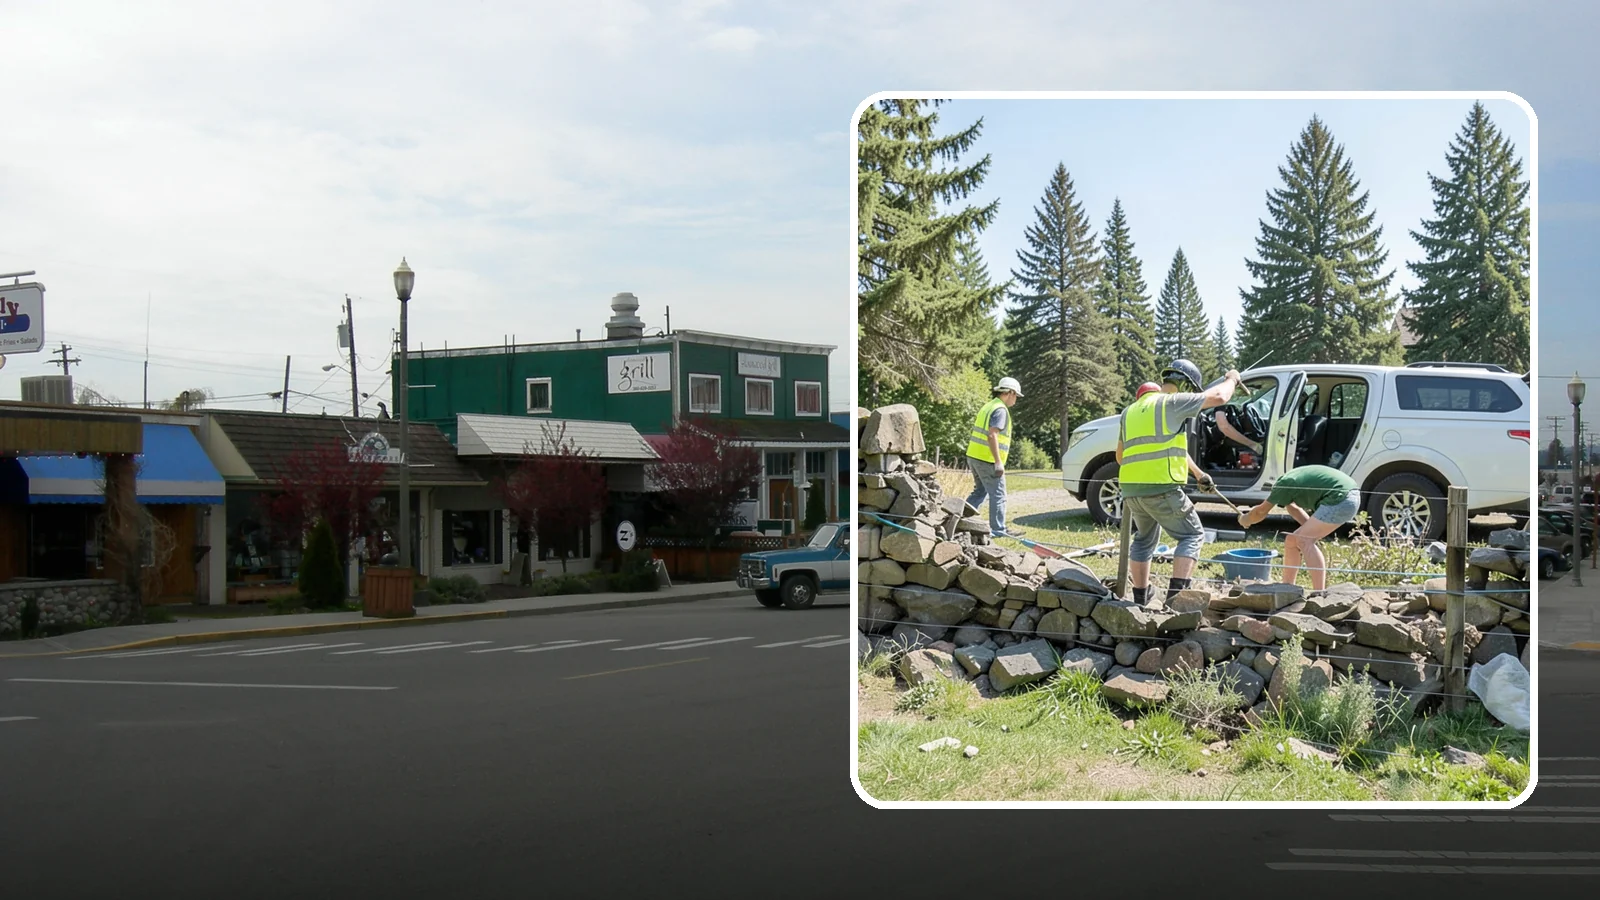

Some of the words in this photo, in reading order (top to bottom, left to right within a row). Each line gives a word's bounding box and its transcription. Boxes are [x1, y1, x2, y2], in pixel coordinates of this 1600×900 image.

[3, 338, 16, 346] Fries
[20, 337, 38, 345] Salads
[618, 356, 654, 391] grill
